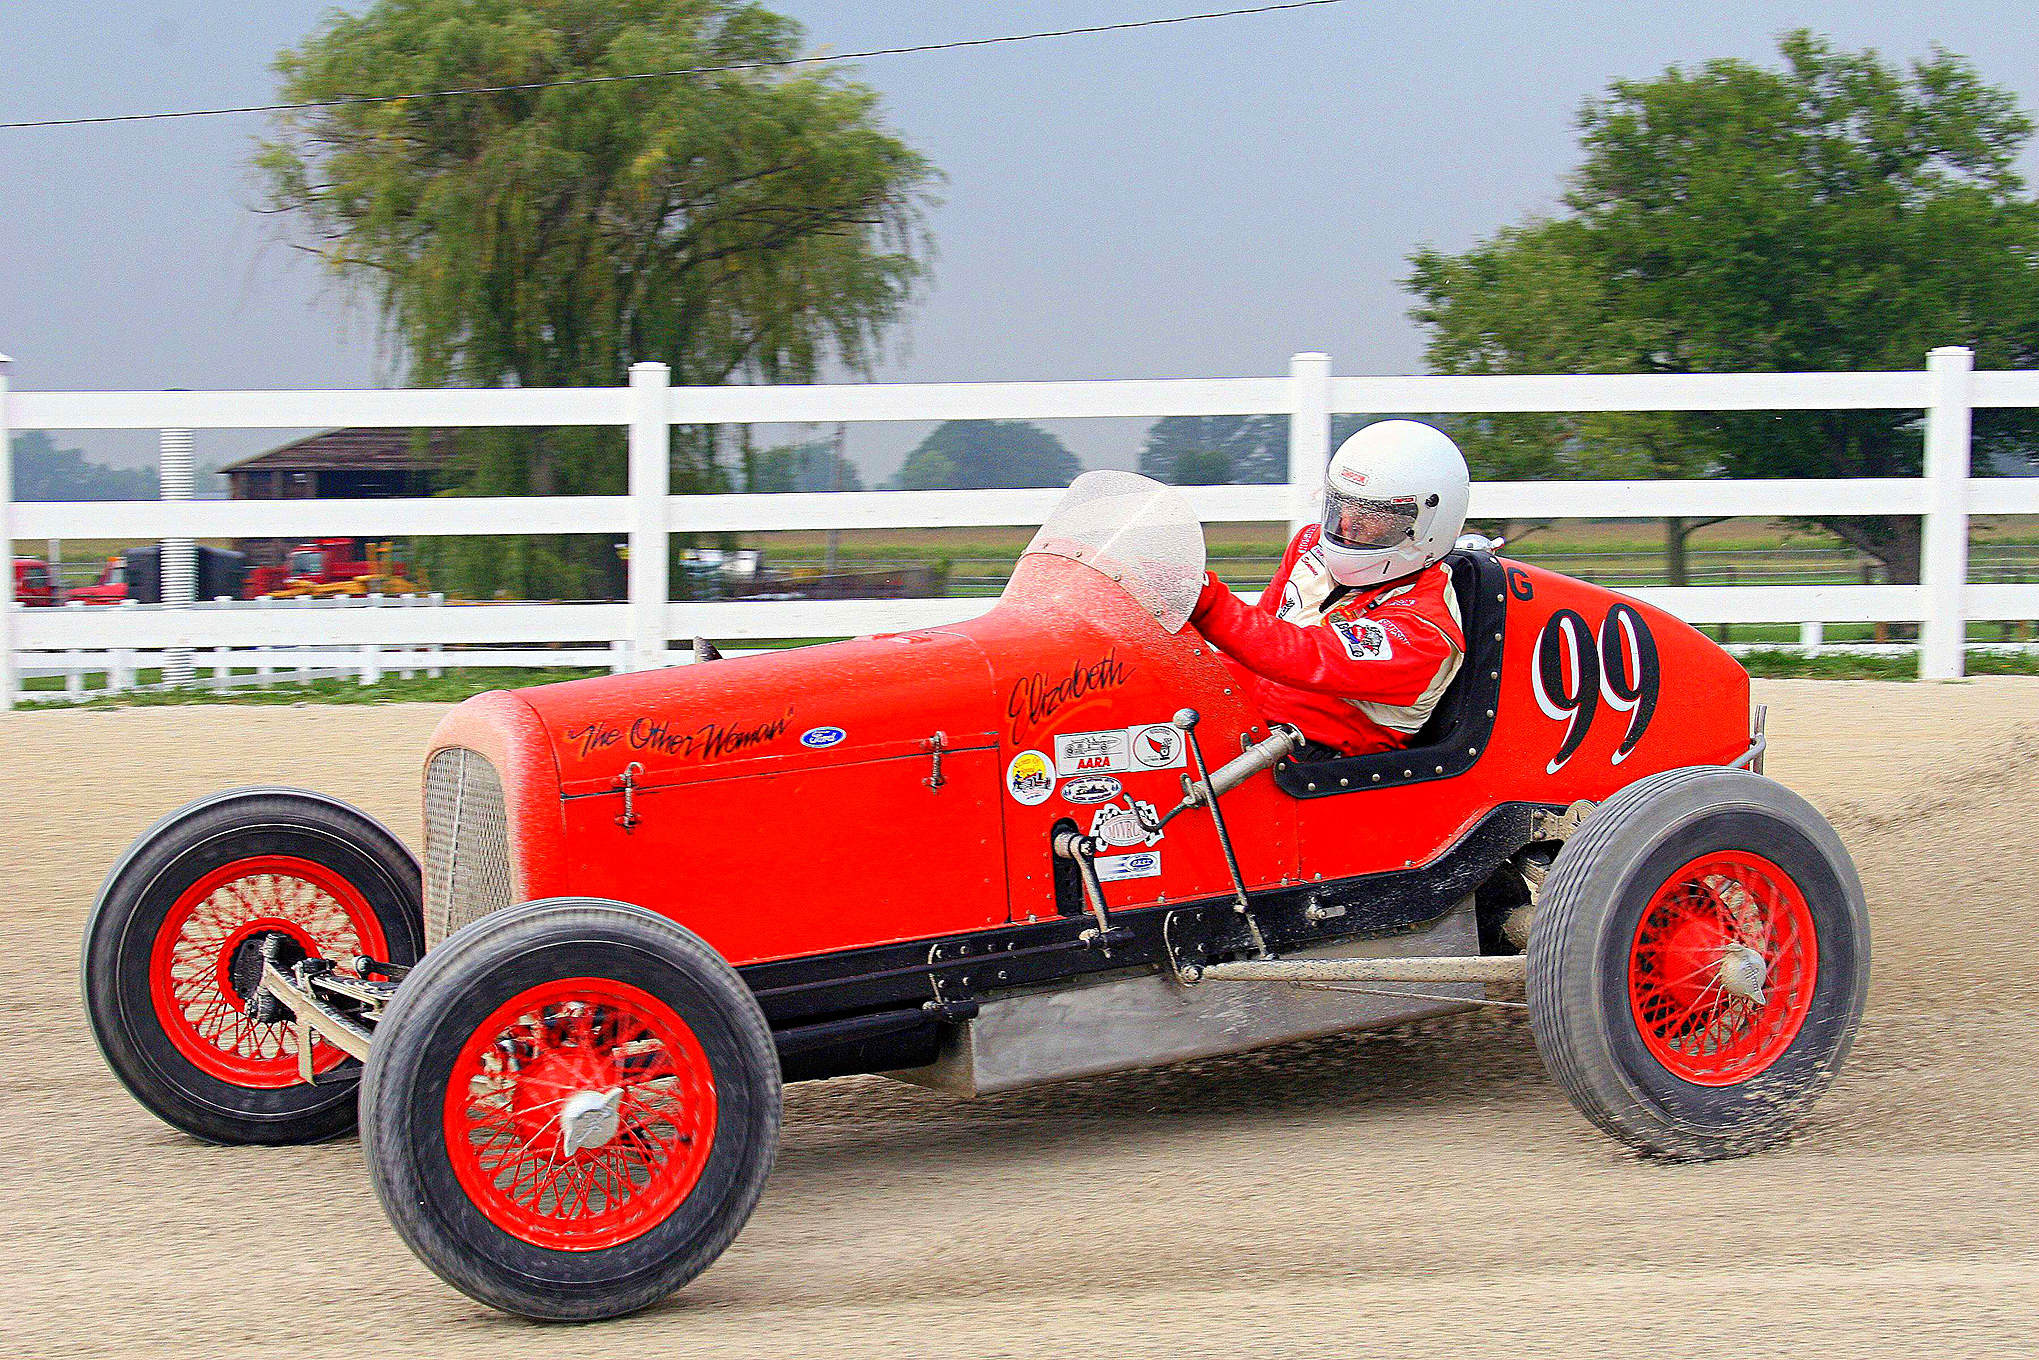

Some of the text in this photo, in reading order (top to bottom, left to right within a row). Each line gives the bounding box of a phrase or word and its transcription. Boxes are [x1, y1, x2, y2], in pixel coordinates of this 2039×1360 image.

[1506, 567, 1534, 601] G
[1008, 647, 1137, 745] Elizabeth
[1532, 603, 1660, 774] 99
[630, 717, 703, 756] Other
[808, 729, 837, 744] Ford
[1076, 756, 1111, 770] AARA
